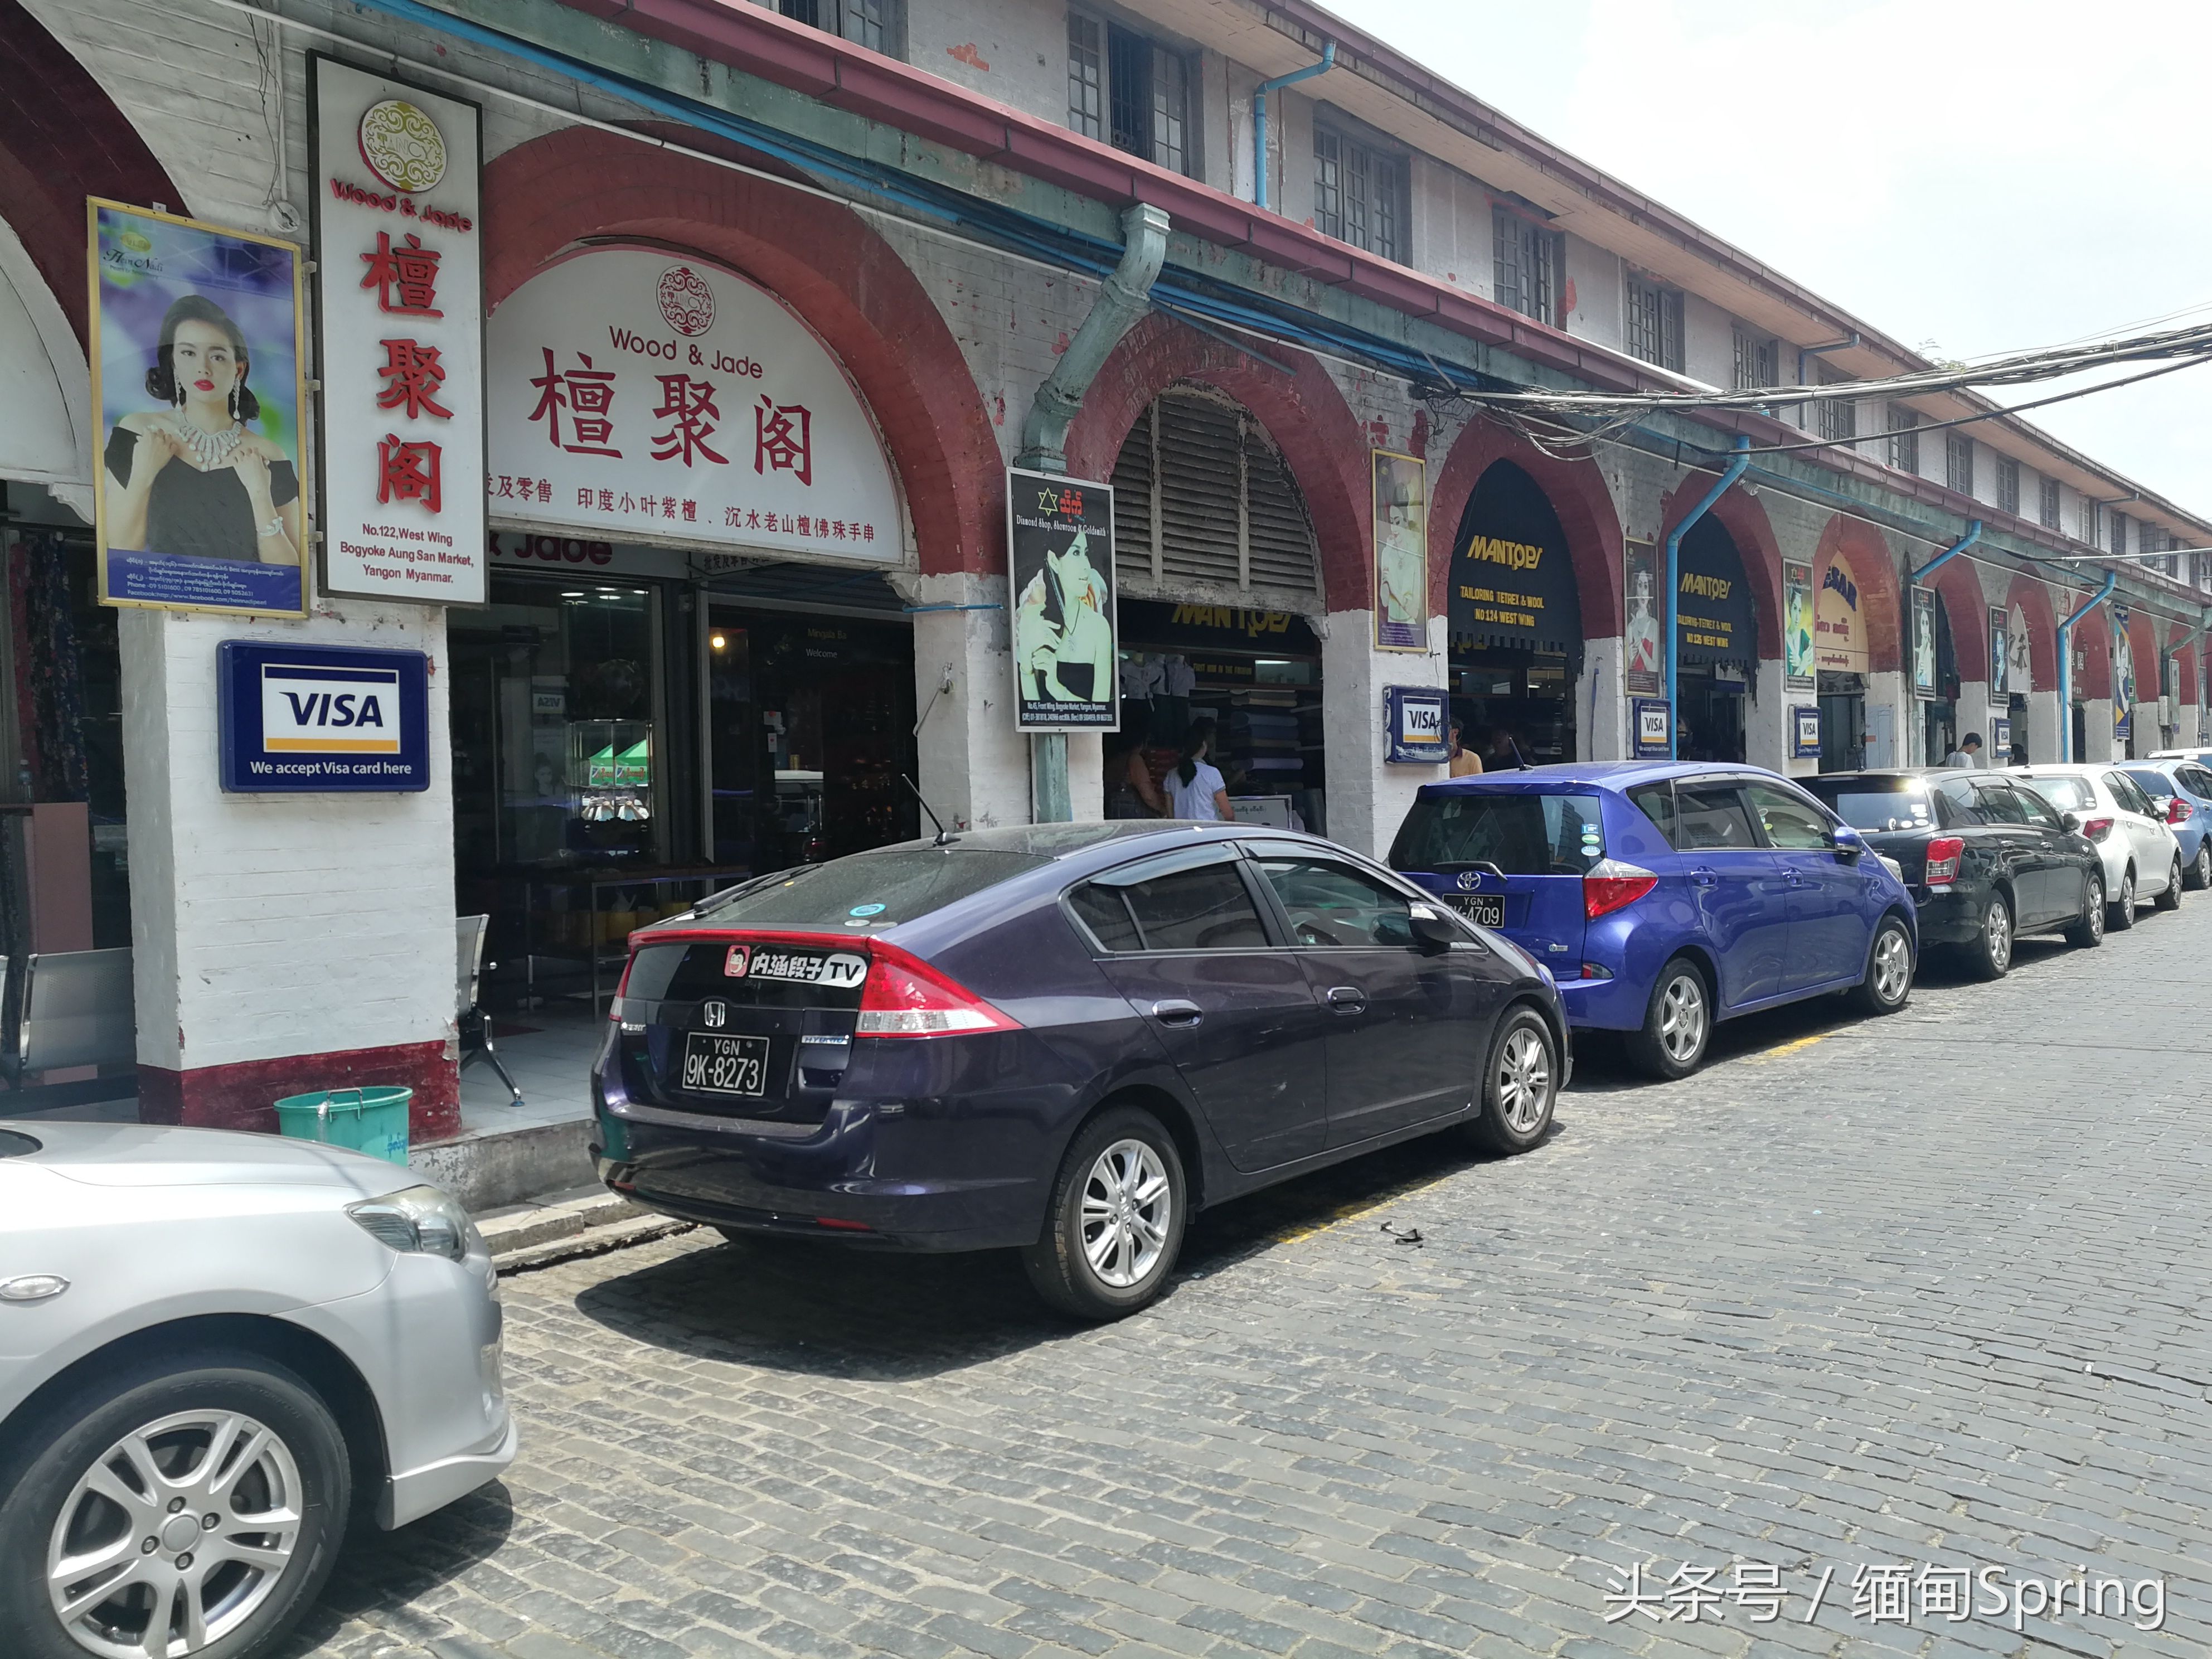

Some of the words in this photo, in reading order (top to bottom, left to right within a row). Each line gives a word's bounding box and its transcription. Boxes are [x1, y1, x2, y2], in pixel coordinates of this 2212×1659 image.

[330, 178, 396, 212] Wood
[400, 198, 417, 217] &
[420, 205, 473, 233] Jade
[103, 249, 133, 263] Hein
[609, 325, 676, 360] Wood
[688, 344, 704, 366] &
[711, 350, 763, 379] Jade
[1016, 515, 1037, 527] Diamond
[1039, 517, 1052, 531] Shop,
[1054, 520, 1076, 533] Showroom
[1083, 525, 1106, 537] Goldsmith
[428, 531, 453, 547] Wing
[341, 541, 385, 558] Bogyoke
[388, 547, 415, 562] Aung
[416, 550, 435, 562] San
[438, 552, 474, 567] Market,
[363, 564, 401, 580] Yangon
[406, 569, 453, 583] Myanmar.
[1460, 586, 1494, 601] TAILORING
[1496, 591, 1519, 605] TETREX
[1521, 595, 1526, 606] &
[1526, 596, 1544, 608] WOOL
[1499, 612, 1517, 624] WEST
[1518, 613, 1534, 627] WING
[806, 648, 838, 658] Welcome
[279, 691, 383, 727] VISA
[1408, 710, 1436, 729] VISA
[1644, 717, 1663, 732] VISA
[1802, 722, 1816, 735] VISA
[250, 761, 273, 774] We
[276, 762, 321, 777] accept
[322, 762, 350, 774] Visa
[352, 762, 381, 774] card
[383, 763, 412, 775] here
[1464, 897, 1483, 905] YGN
[1449, 906, 1499, 924] -4709
[830, 962, 860, 981] TV
[714, 1039, 740, 1055] YGN
[687, 1054, 759, 1090] 9K-8273
